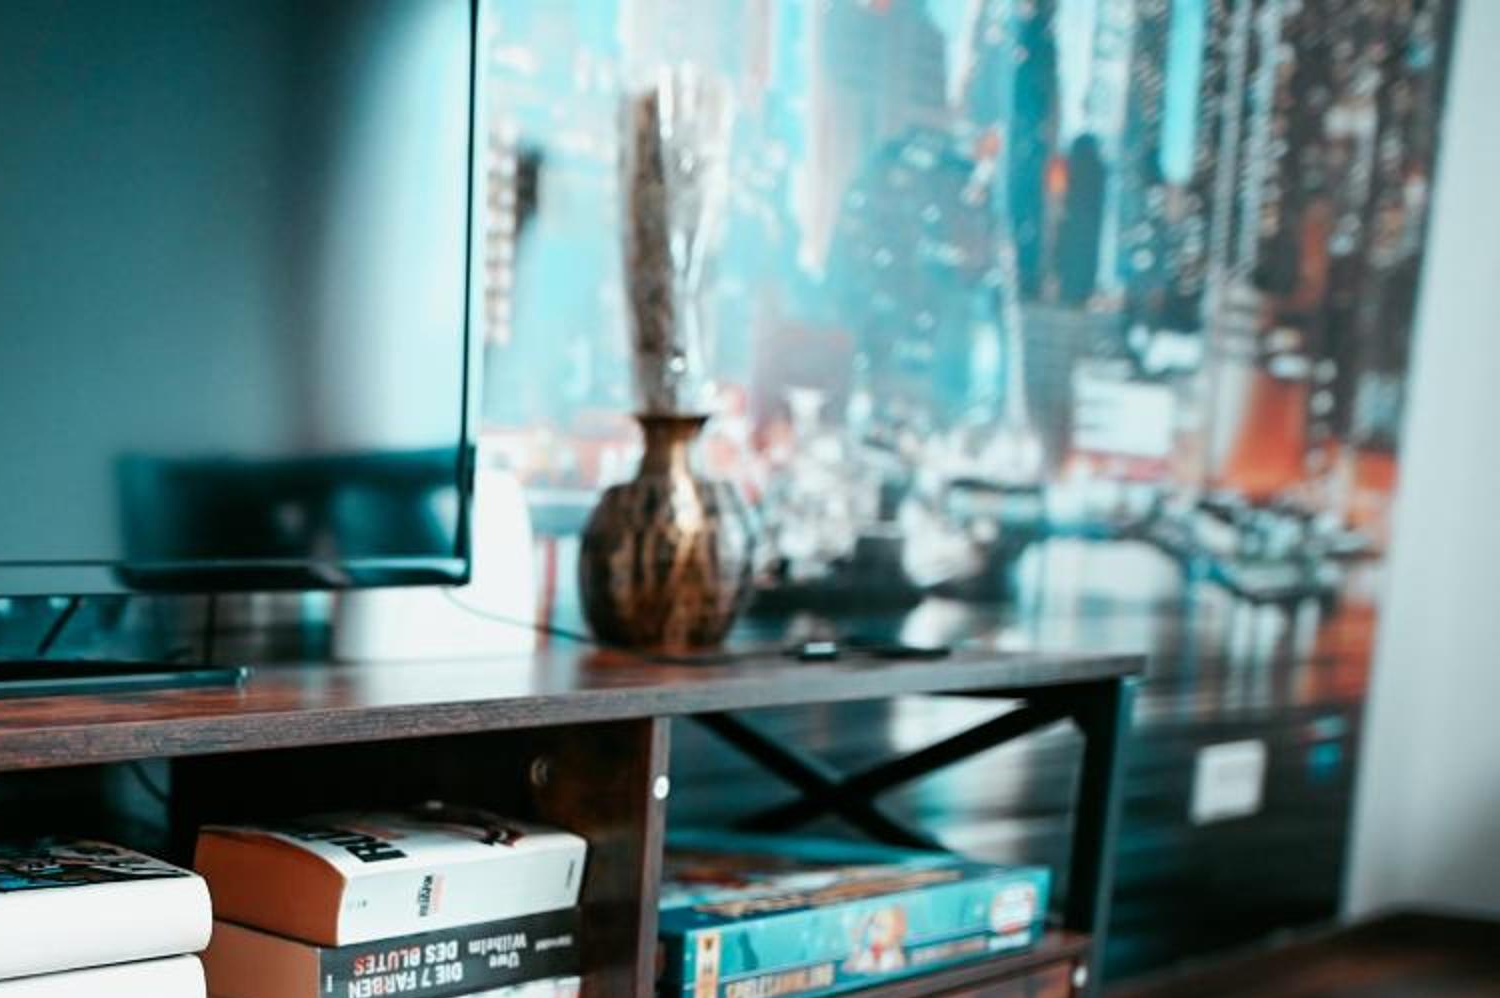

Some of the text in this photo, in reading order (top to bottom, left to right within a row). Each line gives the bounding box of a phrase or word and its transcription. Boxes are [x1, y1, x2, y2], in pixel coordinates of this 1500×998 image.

[468, 932, 527, 956] Wilhelm
[354, 939, 459, 977] DES BLUTES
[489, 951, 520, 969] Uwe
[421, 967, 432, 989] 7
[435, 961, 463, 985] DIE
